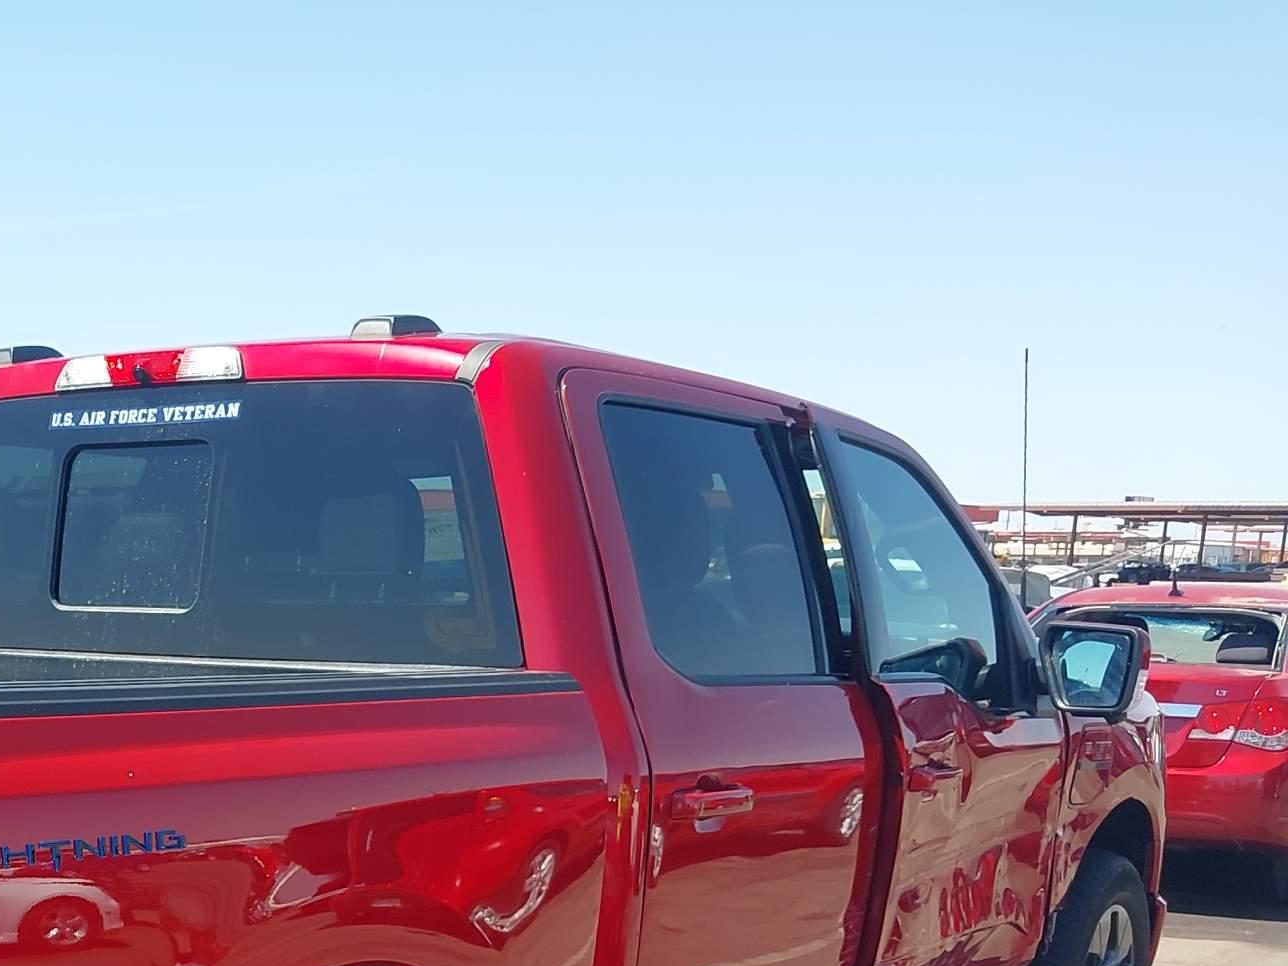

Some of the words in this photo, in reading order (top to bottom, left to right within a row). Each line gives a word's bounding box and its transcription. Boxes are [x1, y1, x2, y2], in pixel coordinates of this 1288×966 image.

[51, 412, 76, 427] U.S.
[79, 411, 106, 426] AIR
[109, 408, 158, 425] FORCE
[162, 402, 241, 422] VETERAN
[1215, 689, 1229, 697] LT
